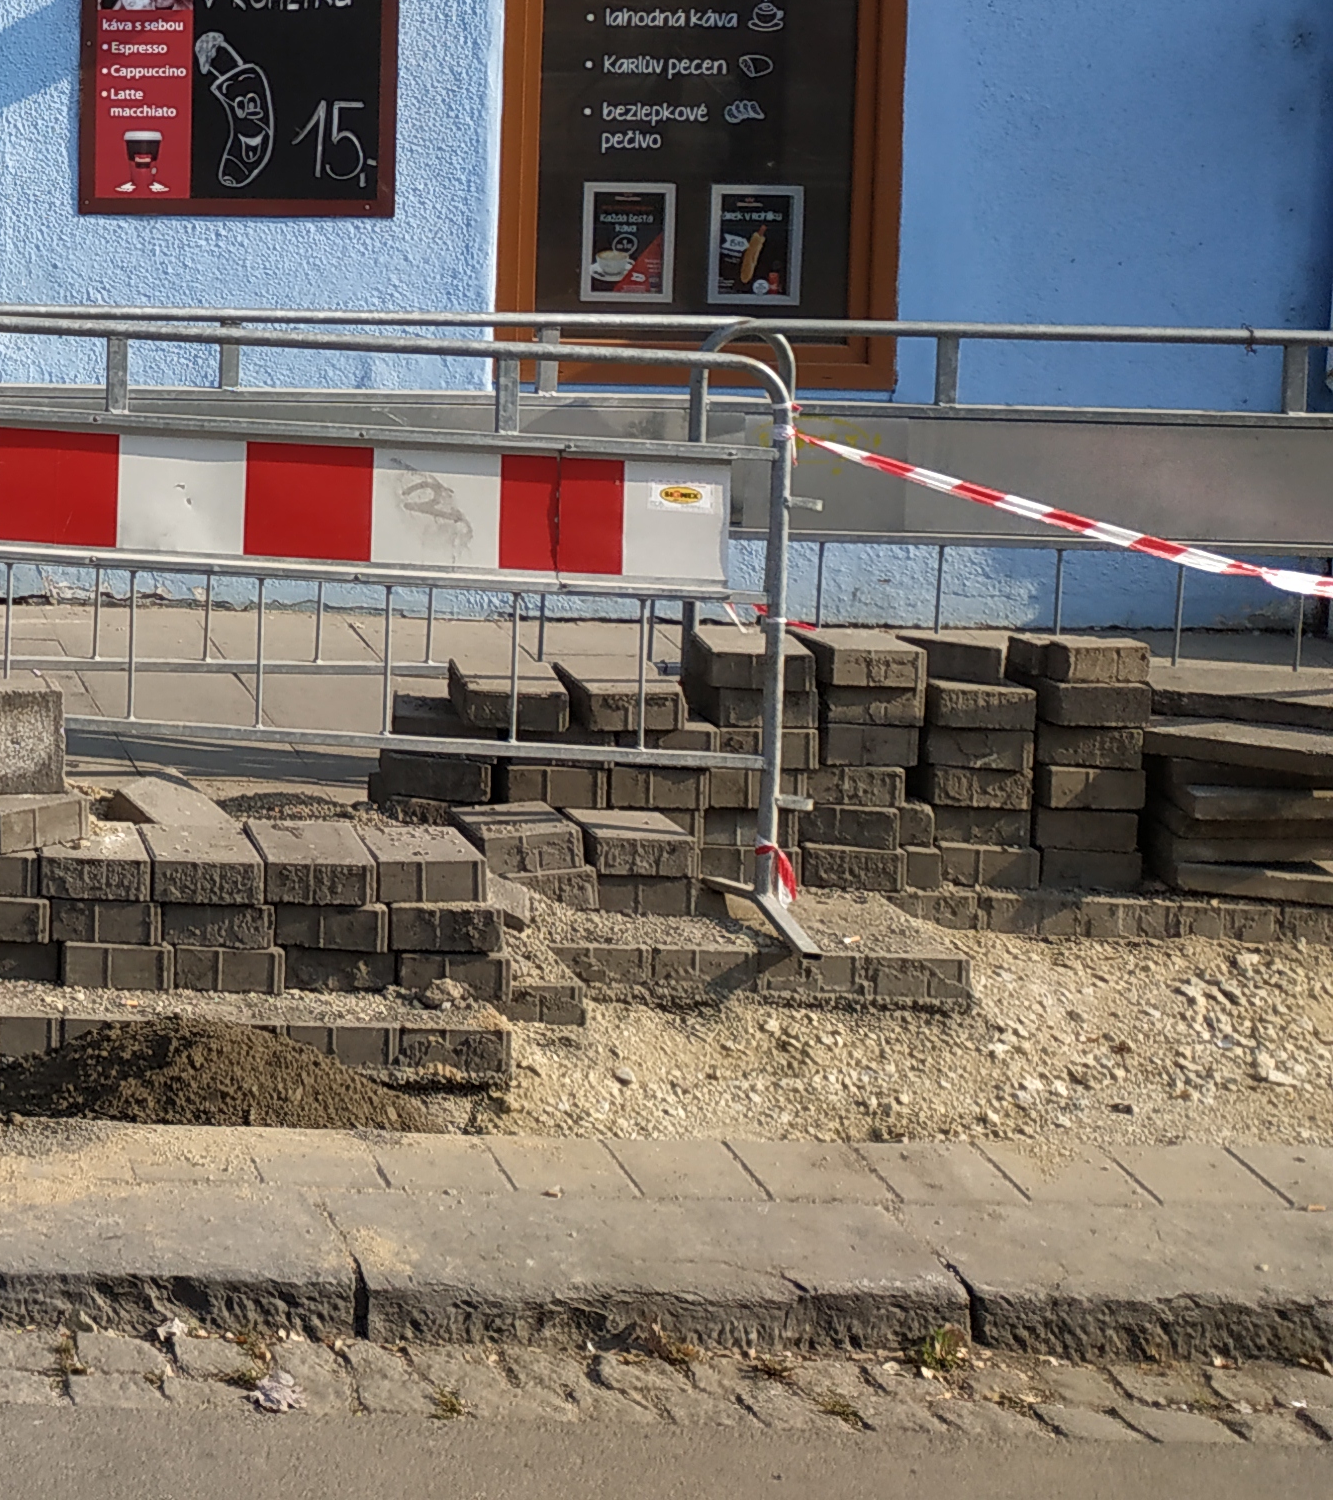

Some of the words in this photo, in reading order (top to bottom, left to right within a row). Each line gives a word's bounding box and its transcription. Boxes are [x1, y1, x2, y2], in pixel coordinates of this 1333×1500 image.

[102, 18, 132, 31] káva
[135, 22, 141, 31] s
[144, 18, 184, 31] sebou
[605, 7, 686, 28] lahodná
[689, 8, 738, 28] káva
[111, 41, 167, 56] Espresso
[110, 65, 186, 80] Cappuccino
[667, 58, 728, 80] pecen
[110, 88, 144, 100] Latte
[110, 105, 177, 118] macchiato
[602, 102, 709, 126] bezlepkové
[601, 130, 662, 154] pečivo
